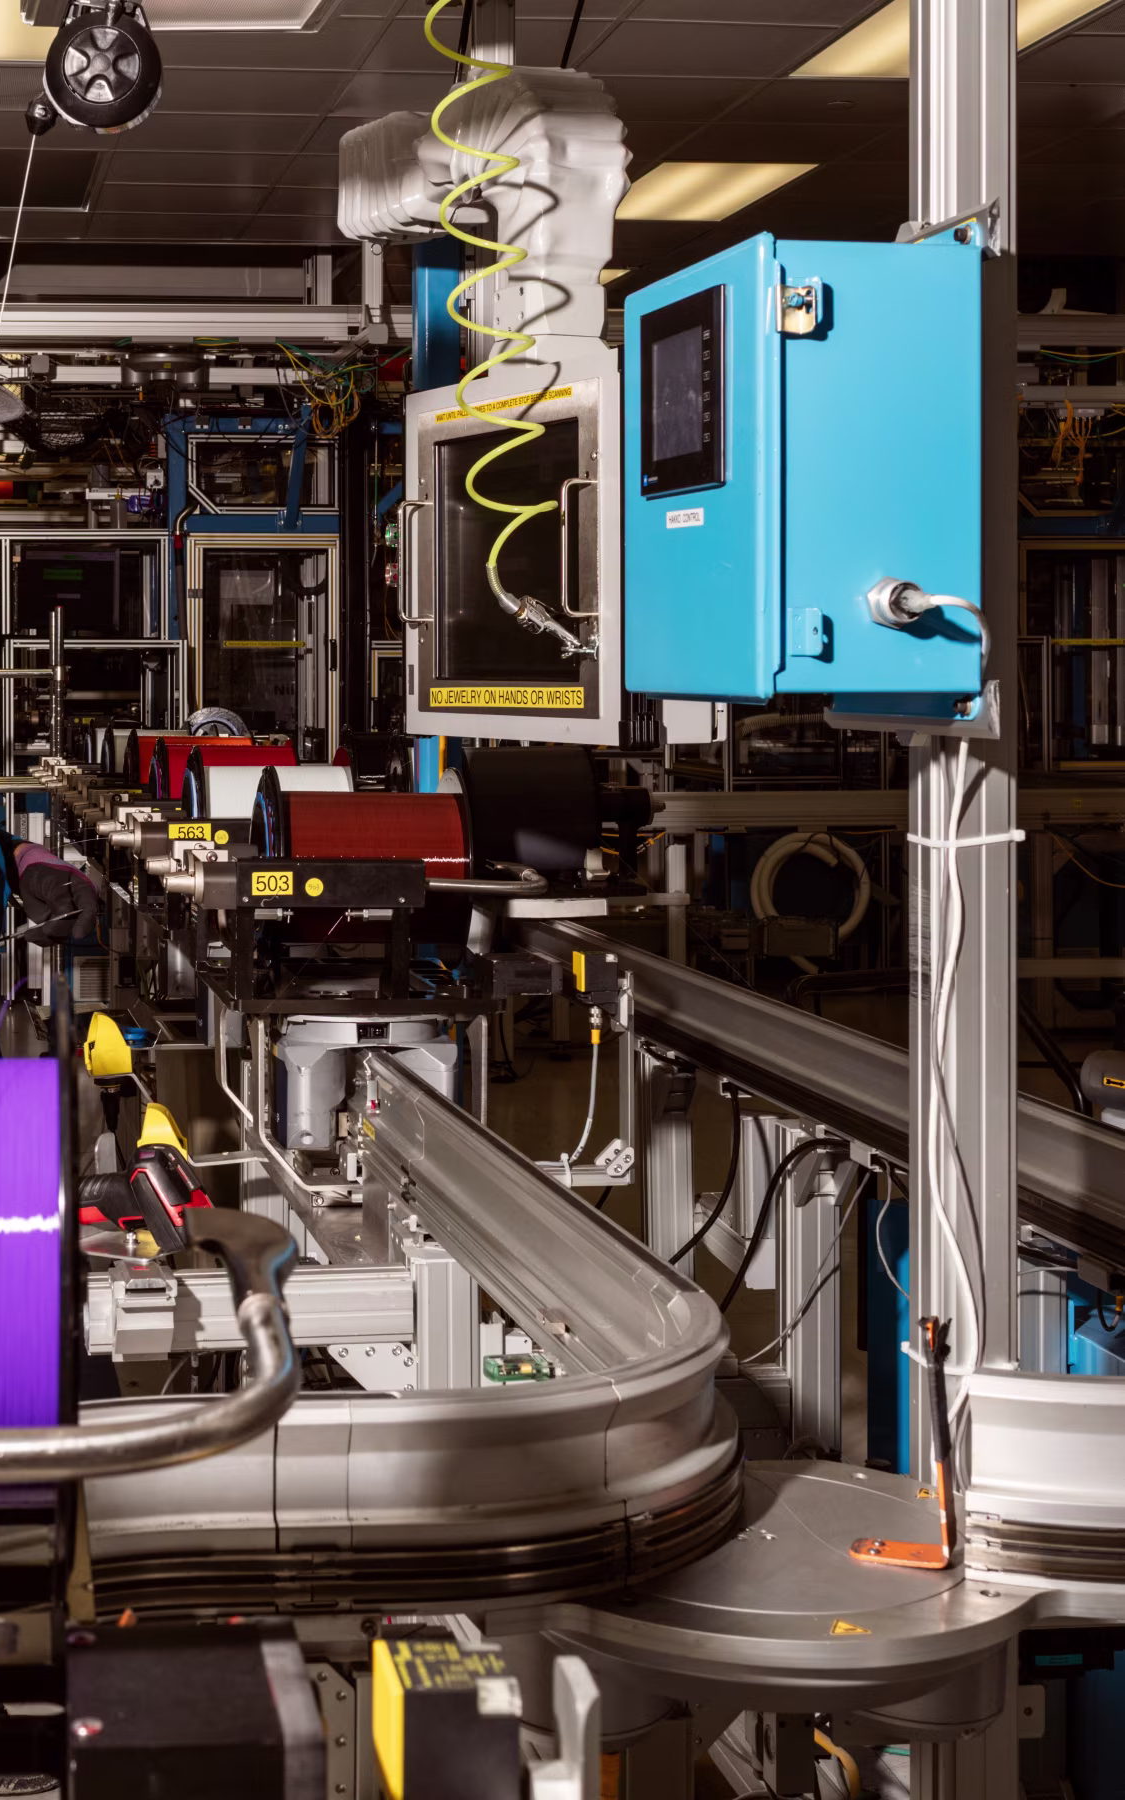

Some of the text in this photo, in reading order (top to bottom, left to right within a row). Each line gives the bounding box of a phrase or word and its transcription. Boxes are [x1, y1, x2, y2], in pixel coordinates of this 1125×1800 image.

[436, 413, 446, 422] WAIT
[446, 411, 457, 420] UNTIL
[496, 398, 518, 409] COMPLETE
[518, 395, 530, 405] STOP
[530, 392, 548, 403] BEFORE
[548, 388, 572, 399] SCANNING
[682, 512, 701, 523] CONTROL
[431, 689, 583, 705] NO JEWELRY ON HANDS OR WRISTS
[178, 826, 205, 839] 563
[256, 875, 289, 892] 503
